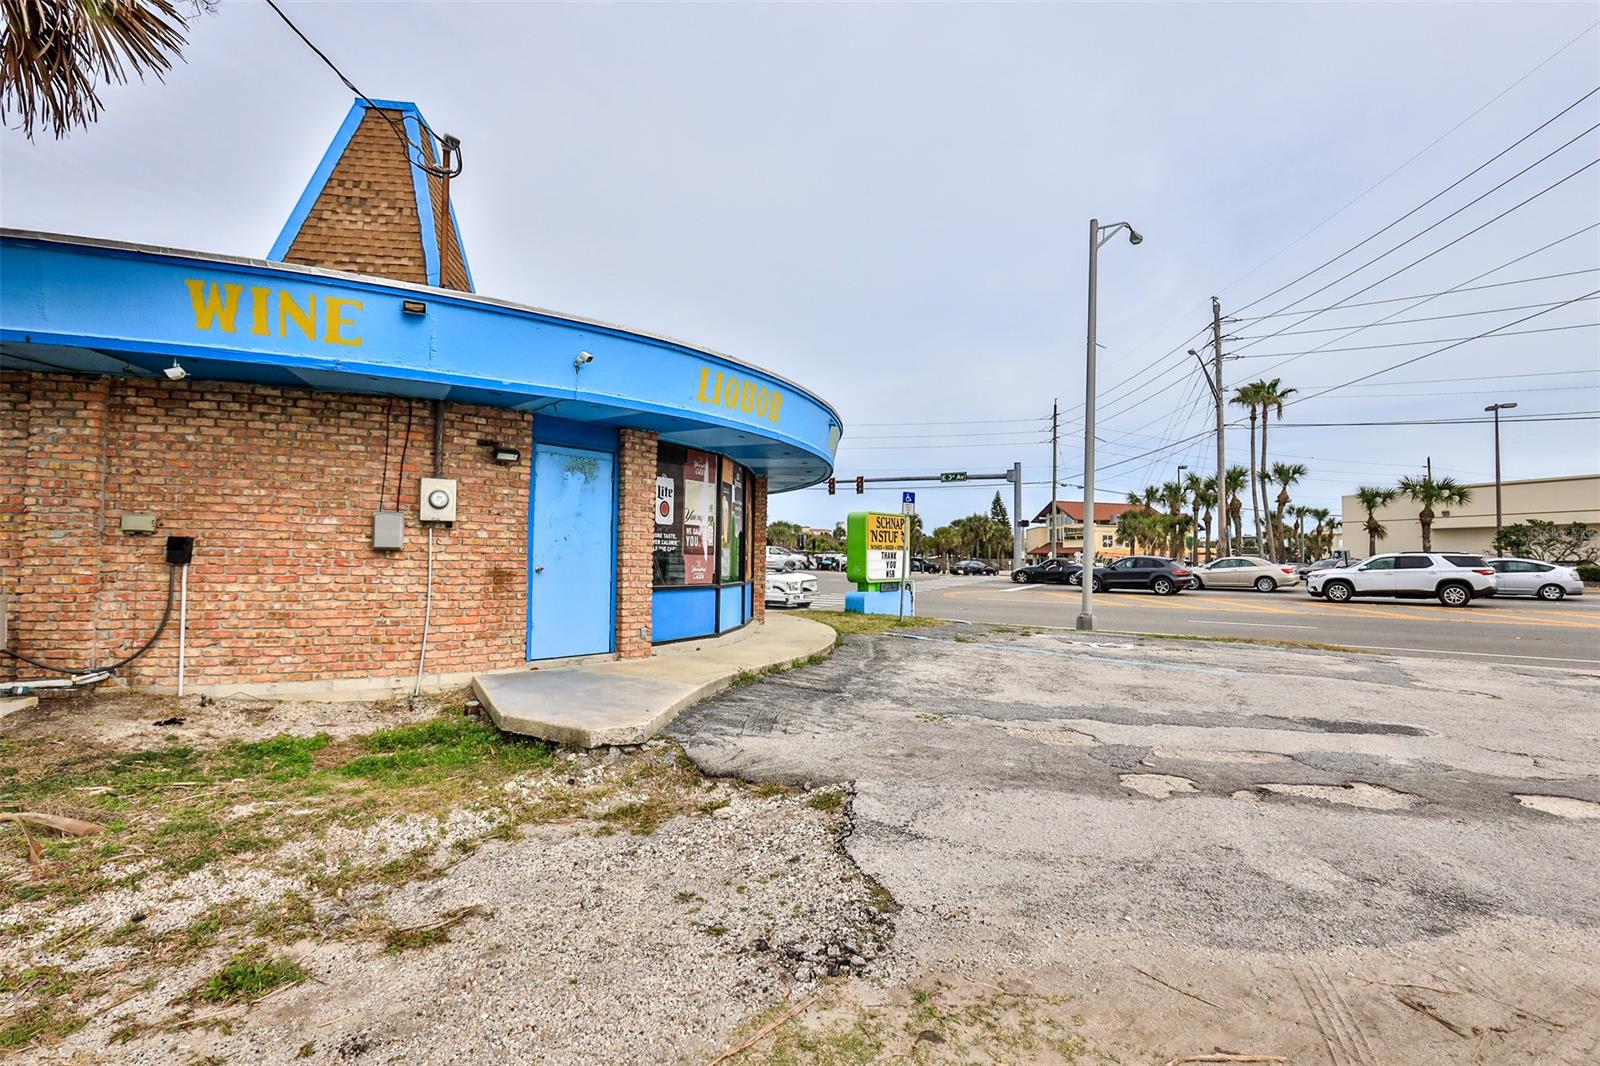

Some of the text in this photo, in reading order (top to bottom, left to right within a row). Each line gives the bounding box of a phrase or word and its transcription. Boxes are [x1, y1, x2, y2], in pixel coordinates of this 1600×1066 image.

[184, 279, 364, 347] WINE
[697, 367, 784, 424] LIQUOR
[657, 485, 673, 500] Lite
[885, 561, 896, 569] YOU
